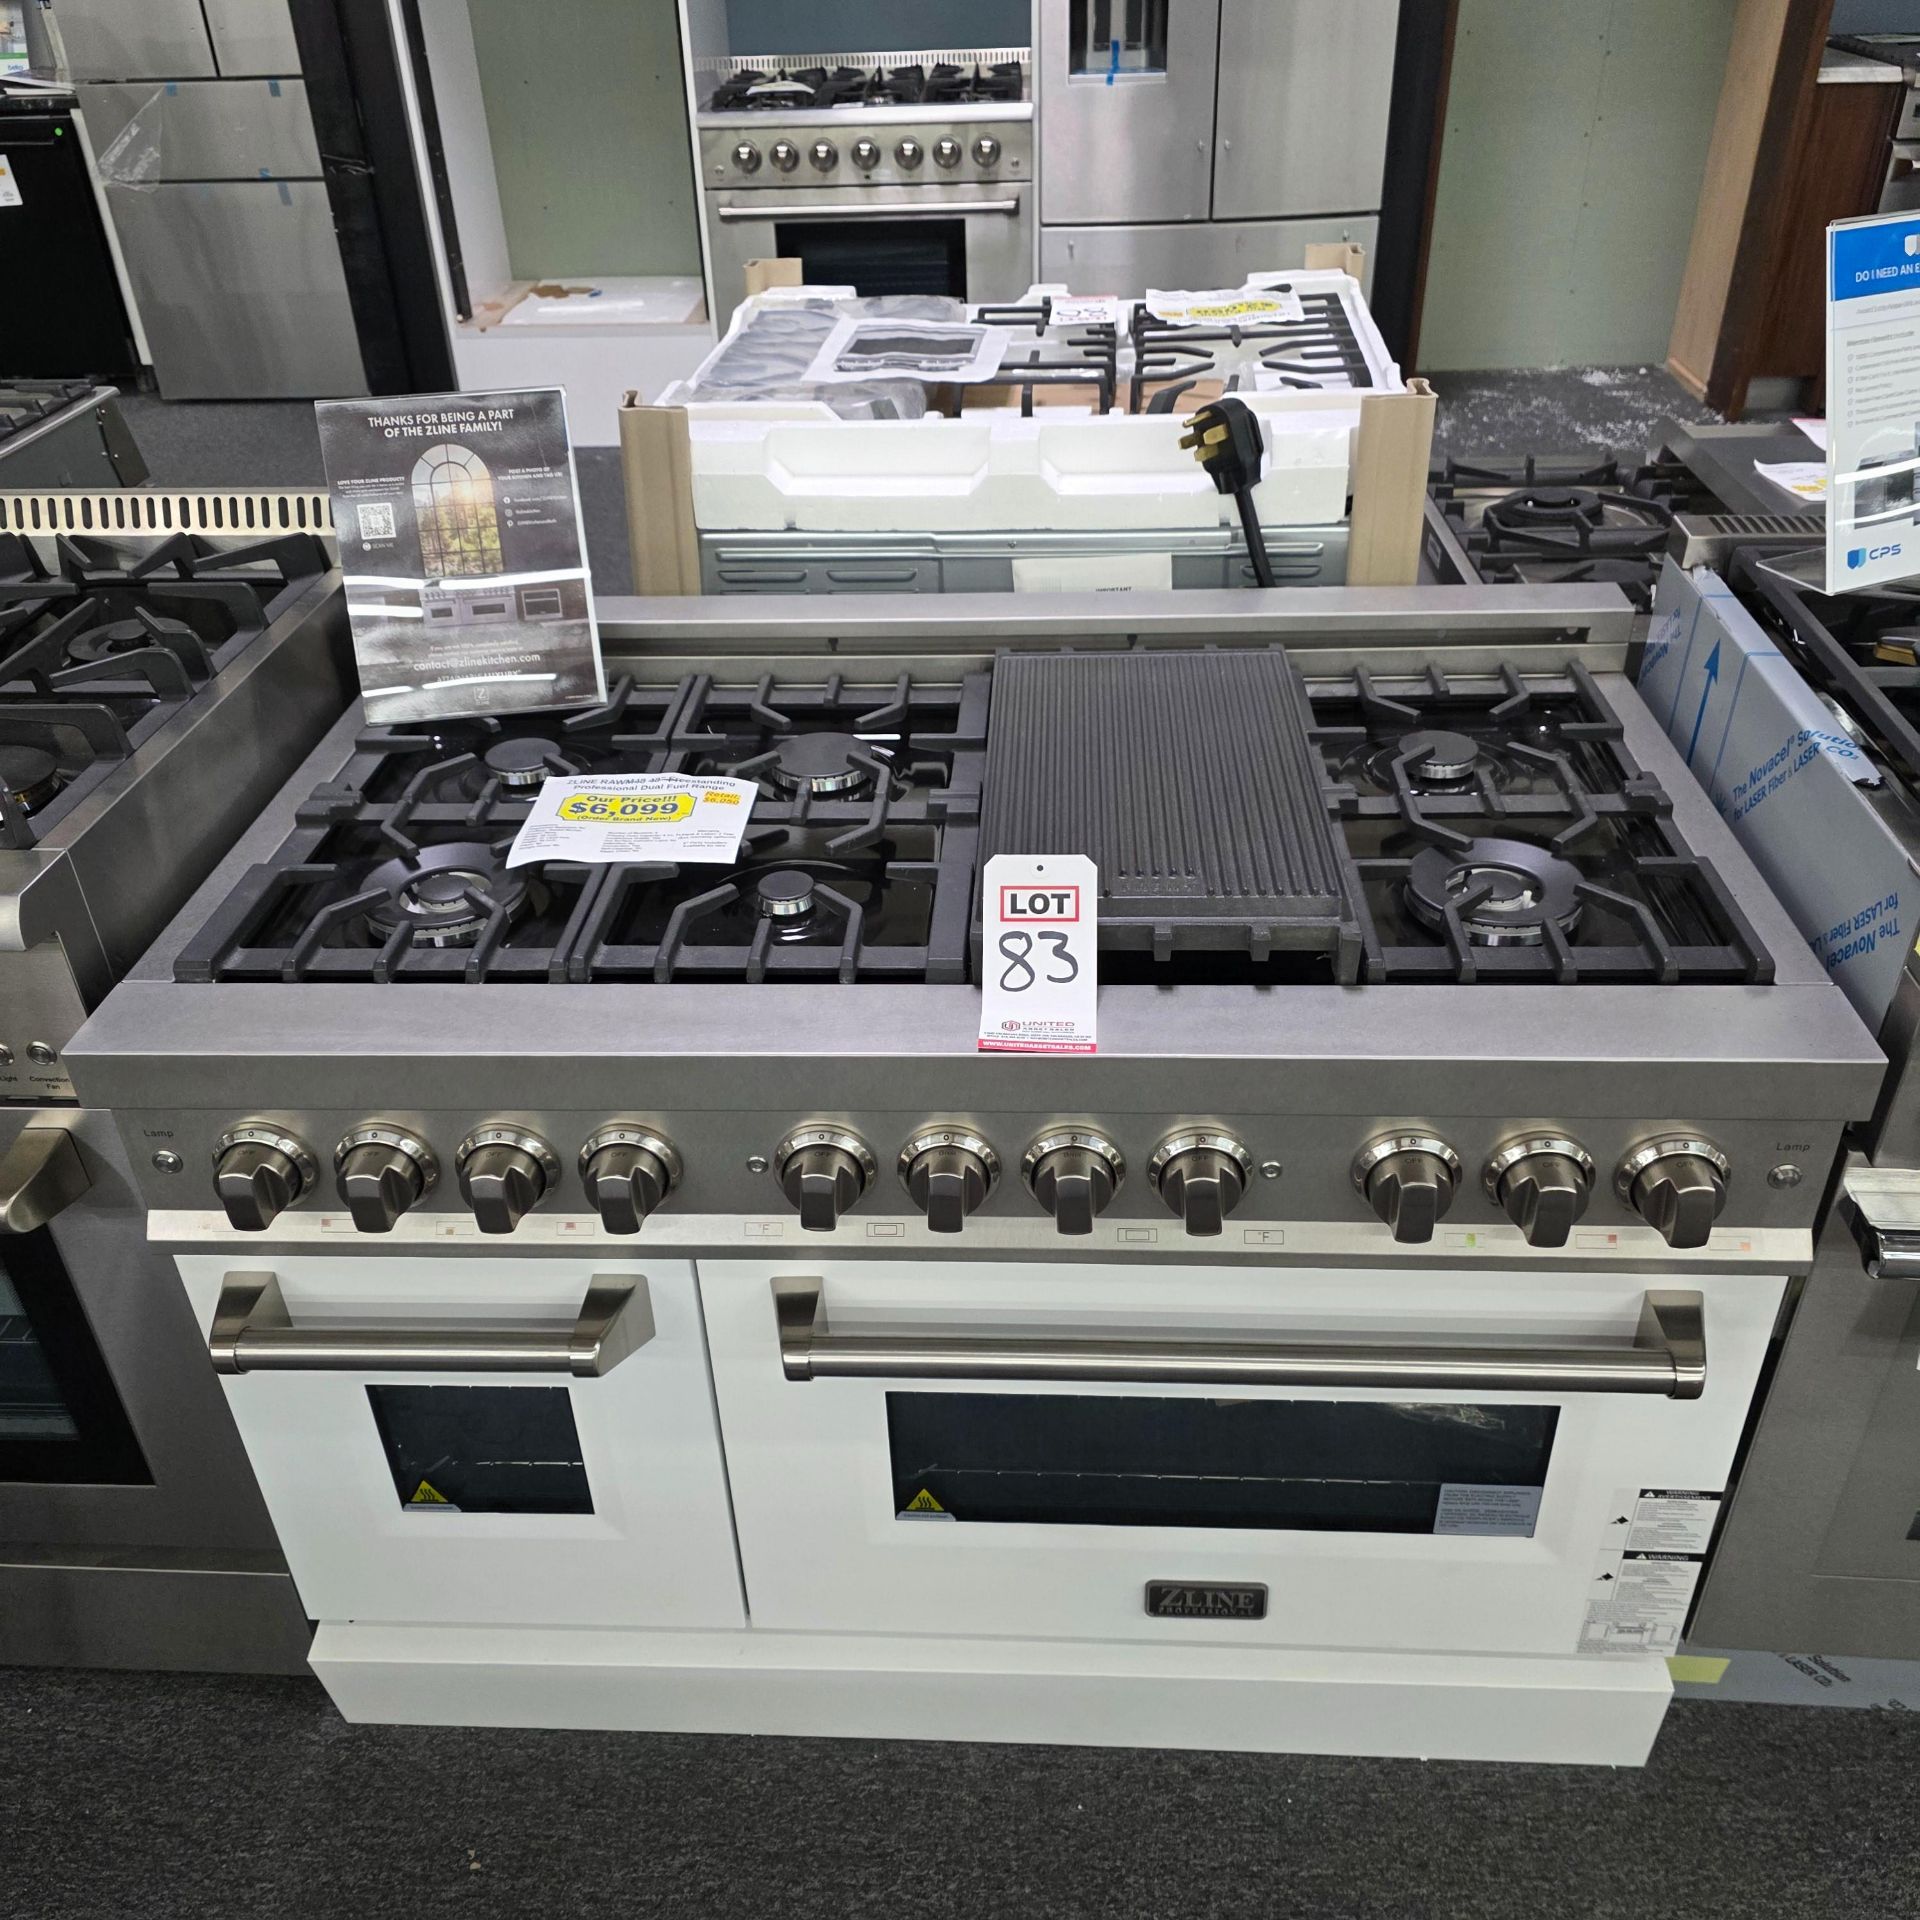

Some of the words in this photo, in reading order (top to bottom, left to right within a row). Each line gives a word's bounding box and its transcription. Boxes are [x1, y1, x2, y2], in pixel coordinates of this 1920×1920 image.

[1855, 270, 1870, 283] DO
[1876, 265, 1899, 279] NEED
[1900, 263, 1914, 276] AN
[367, 415, 414, 428] THANKS
[416, 413, 439, 425] FOR
[441, 411, 476, 423] BEING
[478, 410, 487, 421] A
[488, 409, 514, 420] PART
[384, 427, 401, 438] OF
[402, 426, 423, 437] THE
[425, 424, 458, 436] ZLINE
[460, 421, 503, 433] FAMILY!
[1869, 543, 1901, 560] CPS
[413, 653, 541, 672] contact@zlinekitchen.com
[641, 783, 663, 791] Dual
[1733, 805, 1743, 822] for
[1743, 786, 1767, 814] LASER
[1767, 771, 1787, 797] Fiber
[1793, 741, 1821, 772] LASER
[586, 795, 616, 803] Our
[620, 795, 677, 803] Price!!!
[1733, 783, 1748, 801] The
[568, 801, 679, 818] $6,099
[1009, 893, 1071, 915] LOT
[1884, 891, 1899, 910] for
[1854, 900, 1883, 931] LASER
[1829, 919, 1853, 942] Fiber
[1879, 918, 1901, 938] The
[998, 930, 1079, 993] 83
[143, 1129, 174, 1139] Lamp
[1776, 1142, 1811, 1152] Lamp
[1648, 1553, 1689, 1561] WARNING
[1159, 1586, 1255, 1609] ZLINE
